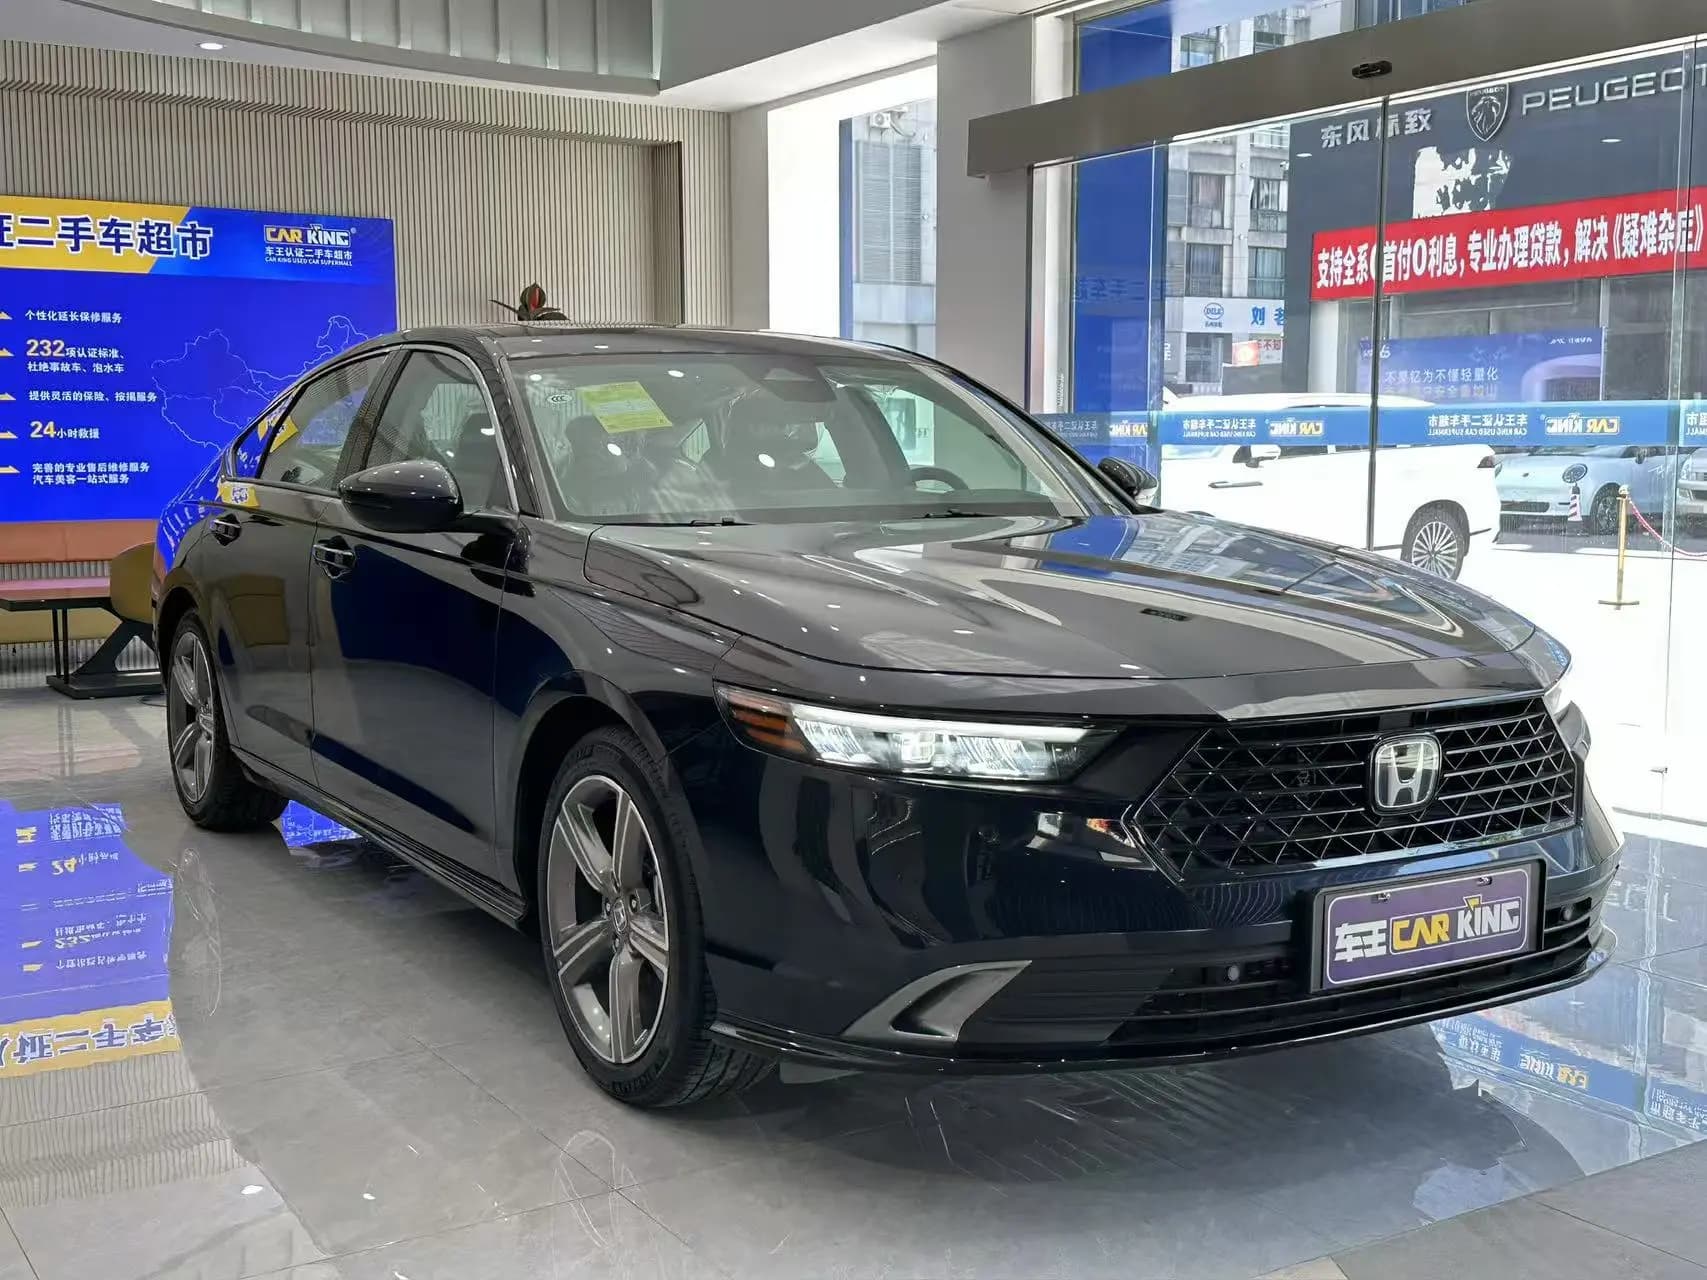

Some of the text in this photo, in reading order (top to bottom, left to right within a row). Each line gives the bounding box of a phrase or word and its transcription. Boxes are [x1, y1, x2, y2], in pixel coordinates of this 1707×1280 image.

[1522, 63, 1707, 116] PEUGEOT
[1320, 108, 1432, 149] 东风标致
[265, 226, 349, 246] CAR KING
[264, 246, 353, 260] 车王认证二手车超市
[25, 309, 122, 324] 个性化延长保修服务
[30, 421, 100, 439] 24小时救援
[32, 462, 150, 473] 完善的专业售后维修服务
[33, 474, 130, 485] 汽车美容一站式服务
[1392, 897, 1520, 951] CAR KING
[1334, 918, 1387, 963] 车王
